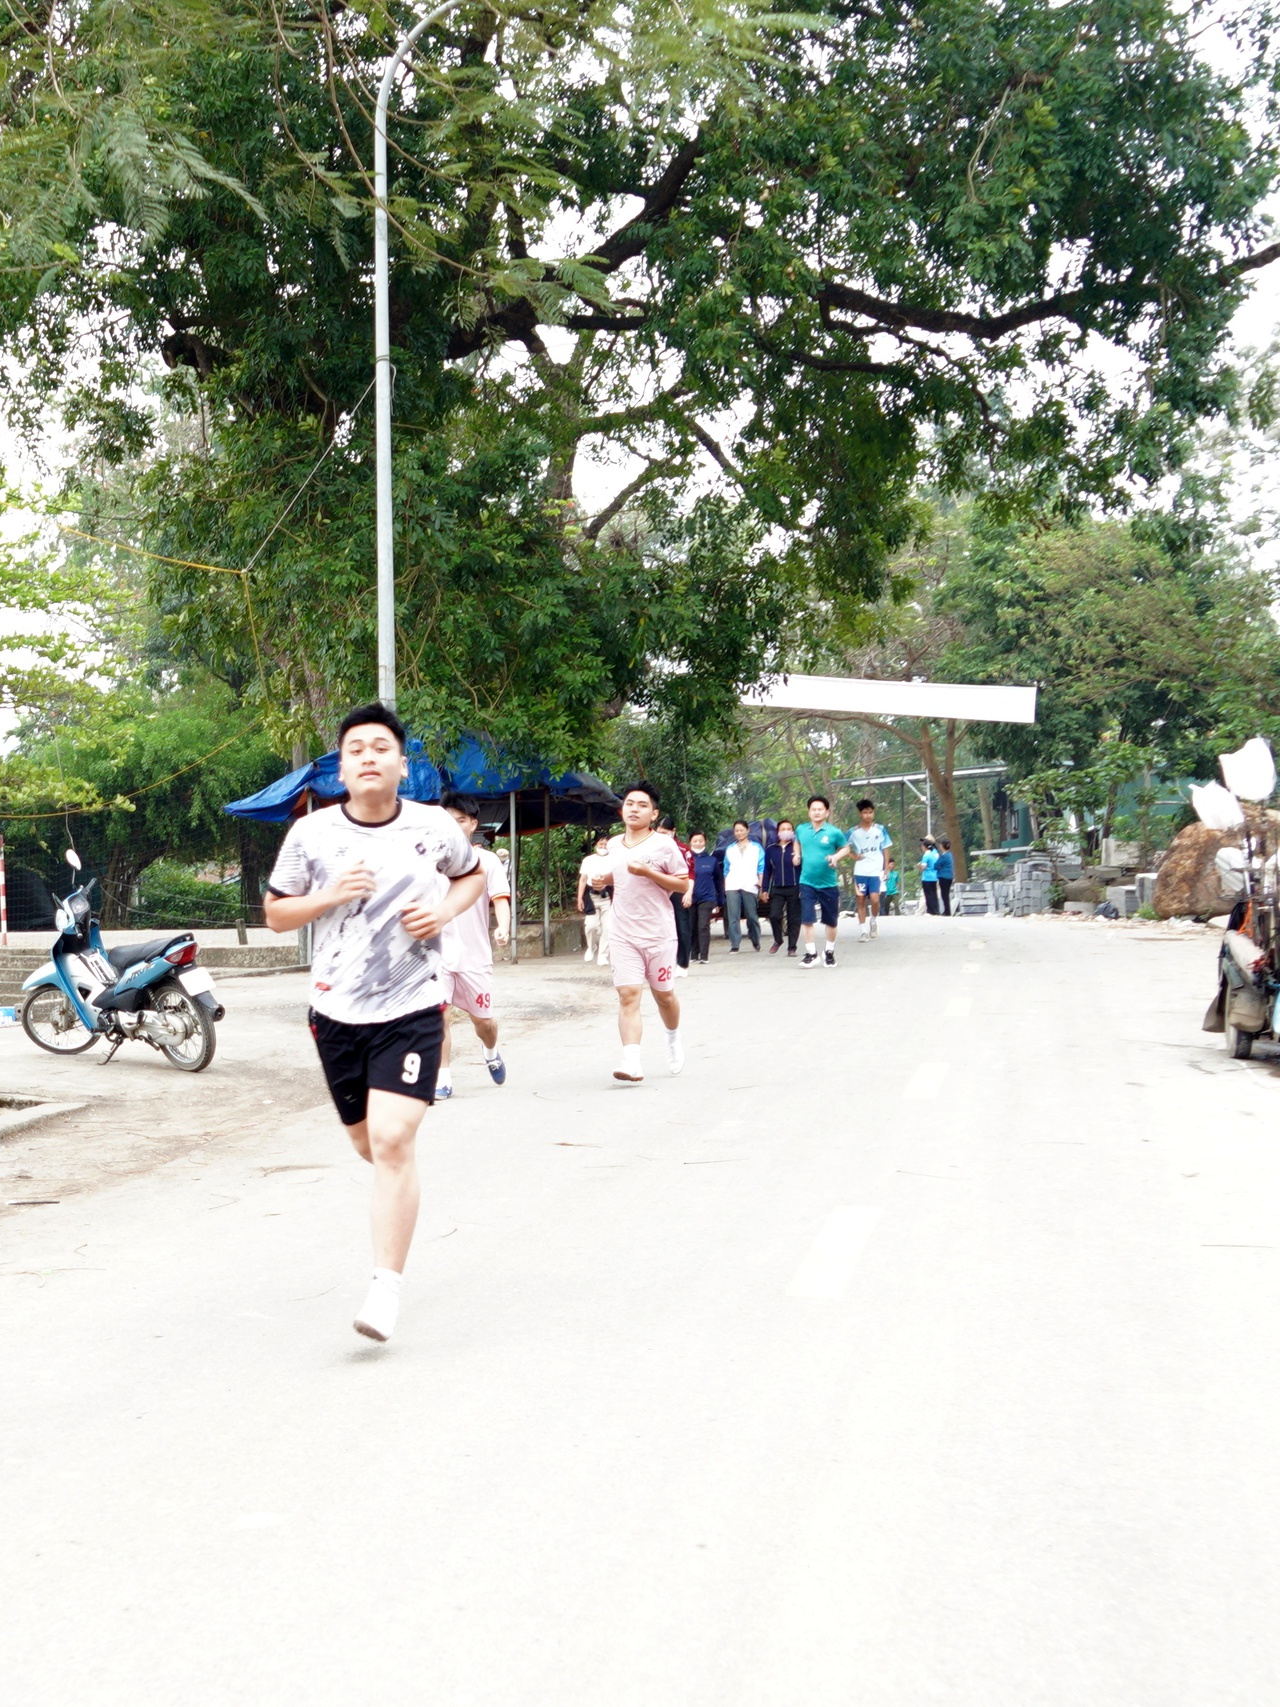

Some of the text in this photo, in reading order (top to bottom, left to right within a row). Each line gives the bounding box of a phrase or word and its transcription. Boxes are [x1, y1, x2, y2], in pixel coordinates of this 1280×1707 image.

[658, 966, 672, 982] 26
[475, 993, 491, 1009] 49
[401, 1052, 421, 1085] 9
